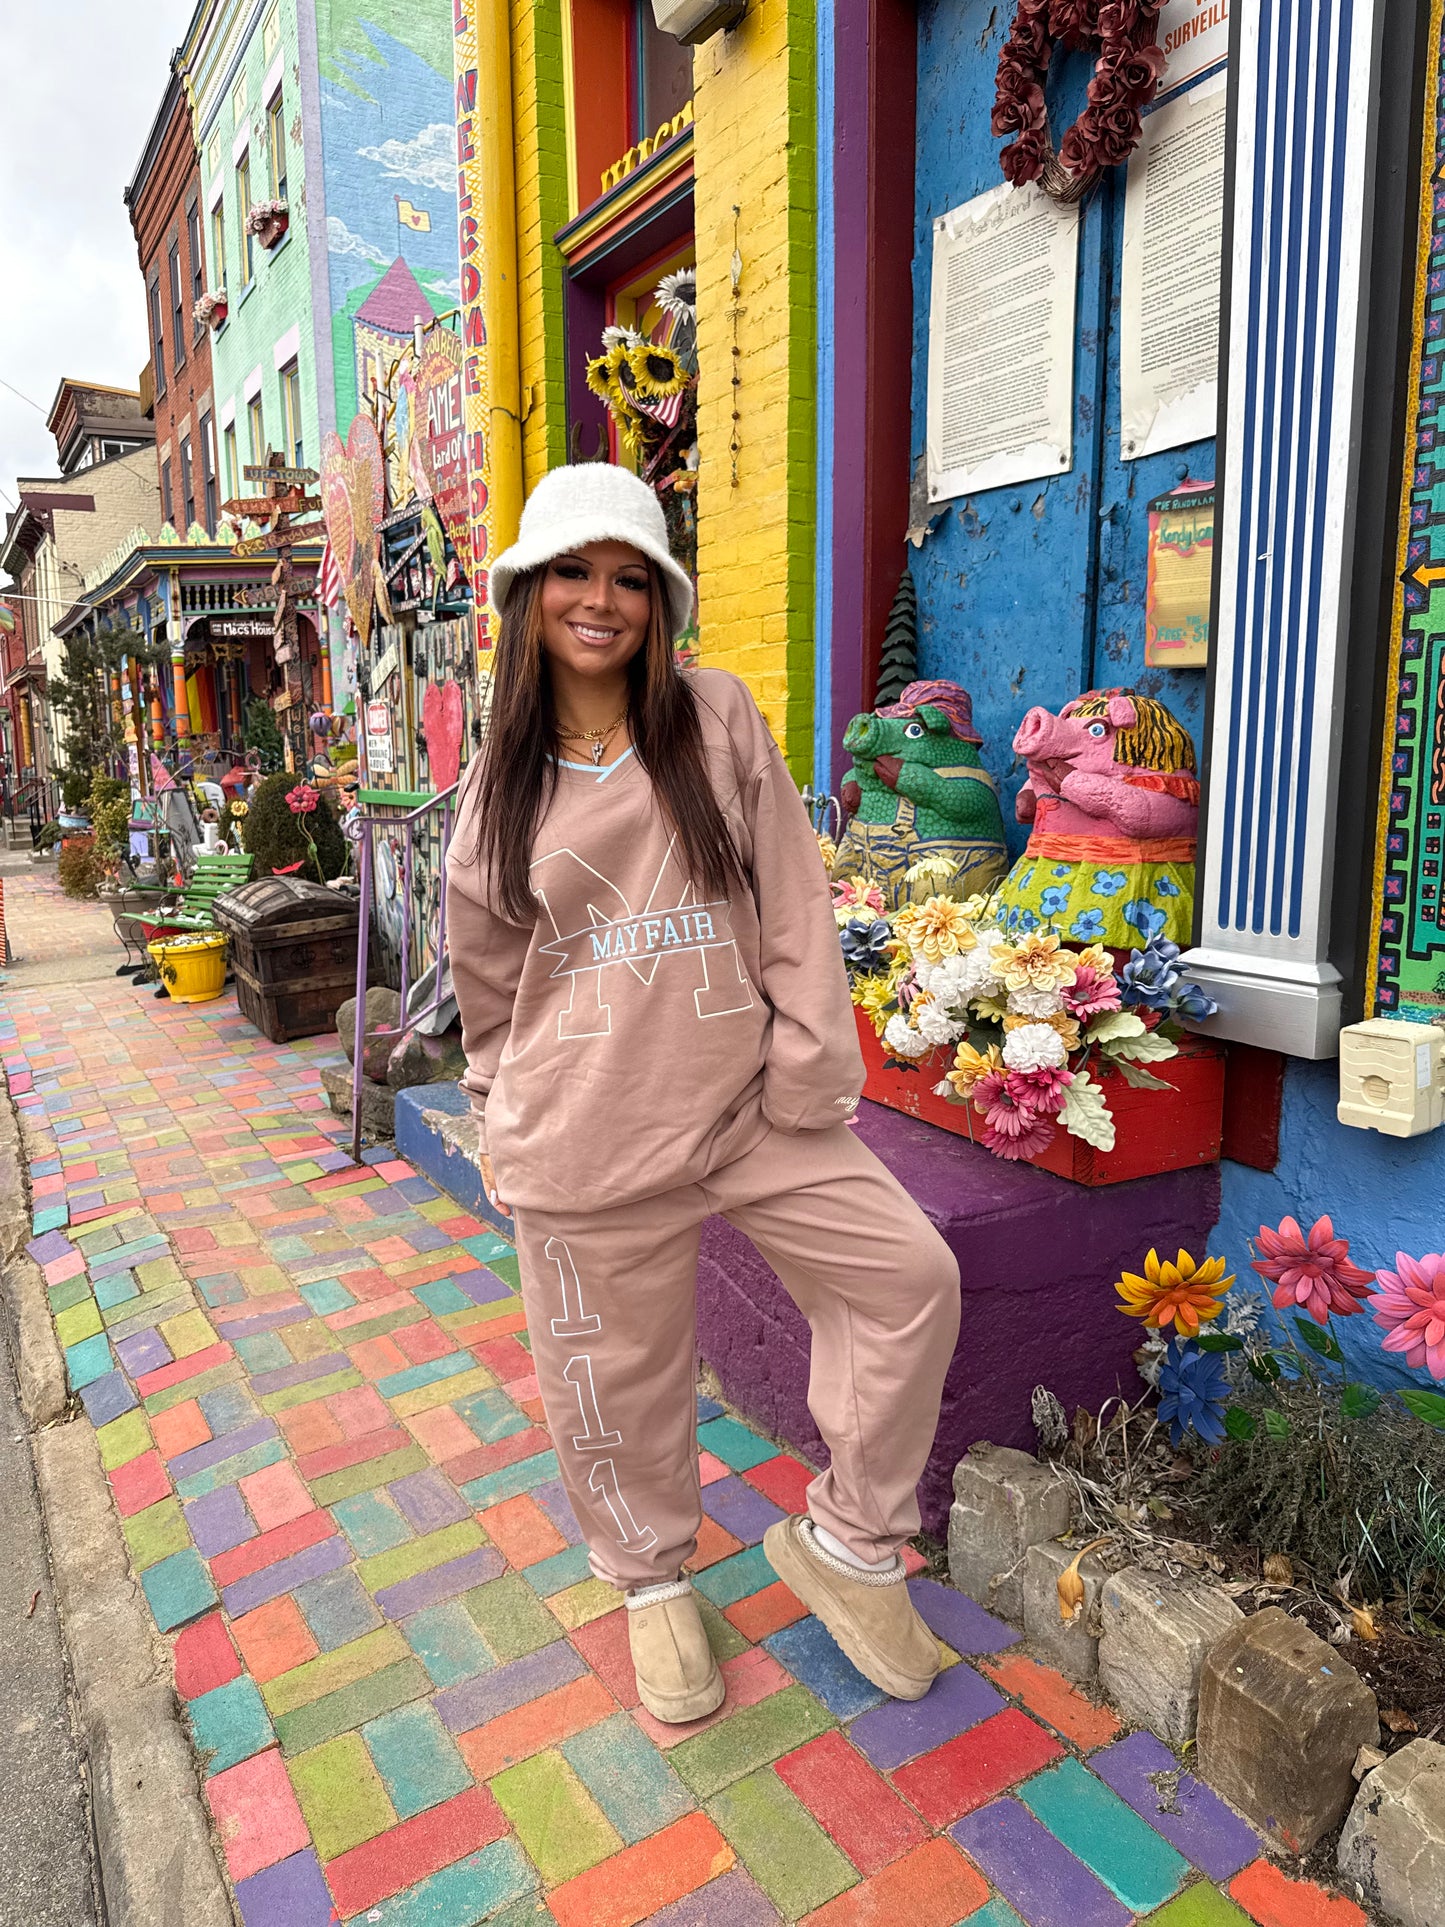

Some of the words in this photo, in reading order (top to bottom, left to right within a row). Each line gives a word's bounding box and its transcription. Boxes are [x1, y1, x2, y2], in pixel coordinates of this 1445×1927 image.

[1164, 0, 1228, 55] SURVEILL
[427, 372, 465, 439] AME
[589, 910, 716, 961] MAYFAIR
